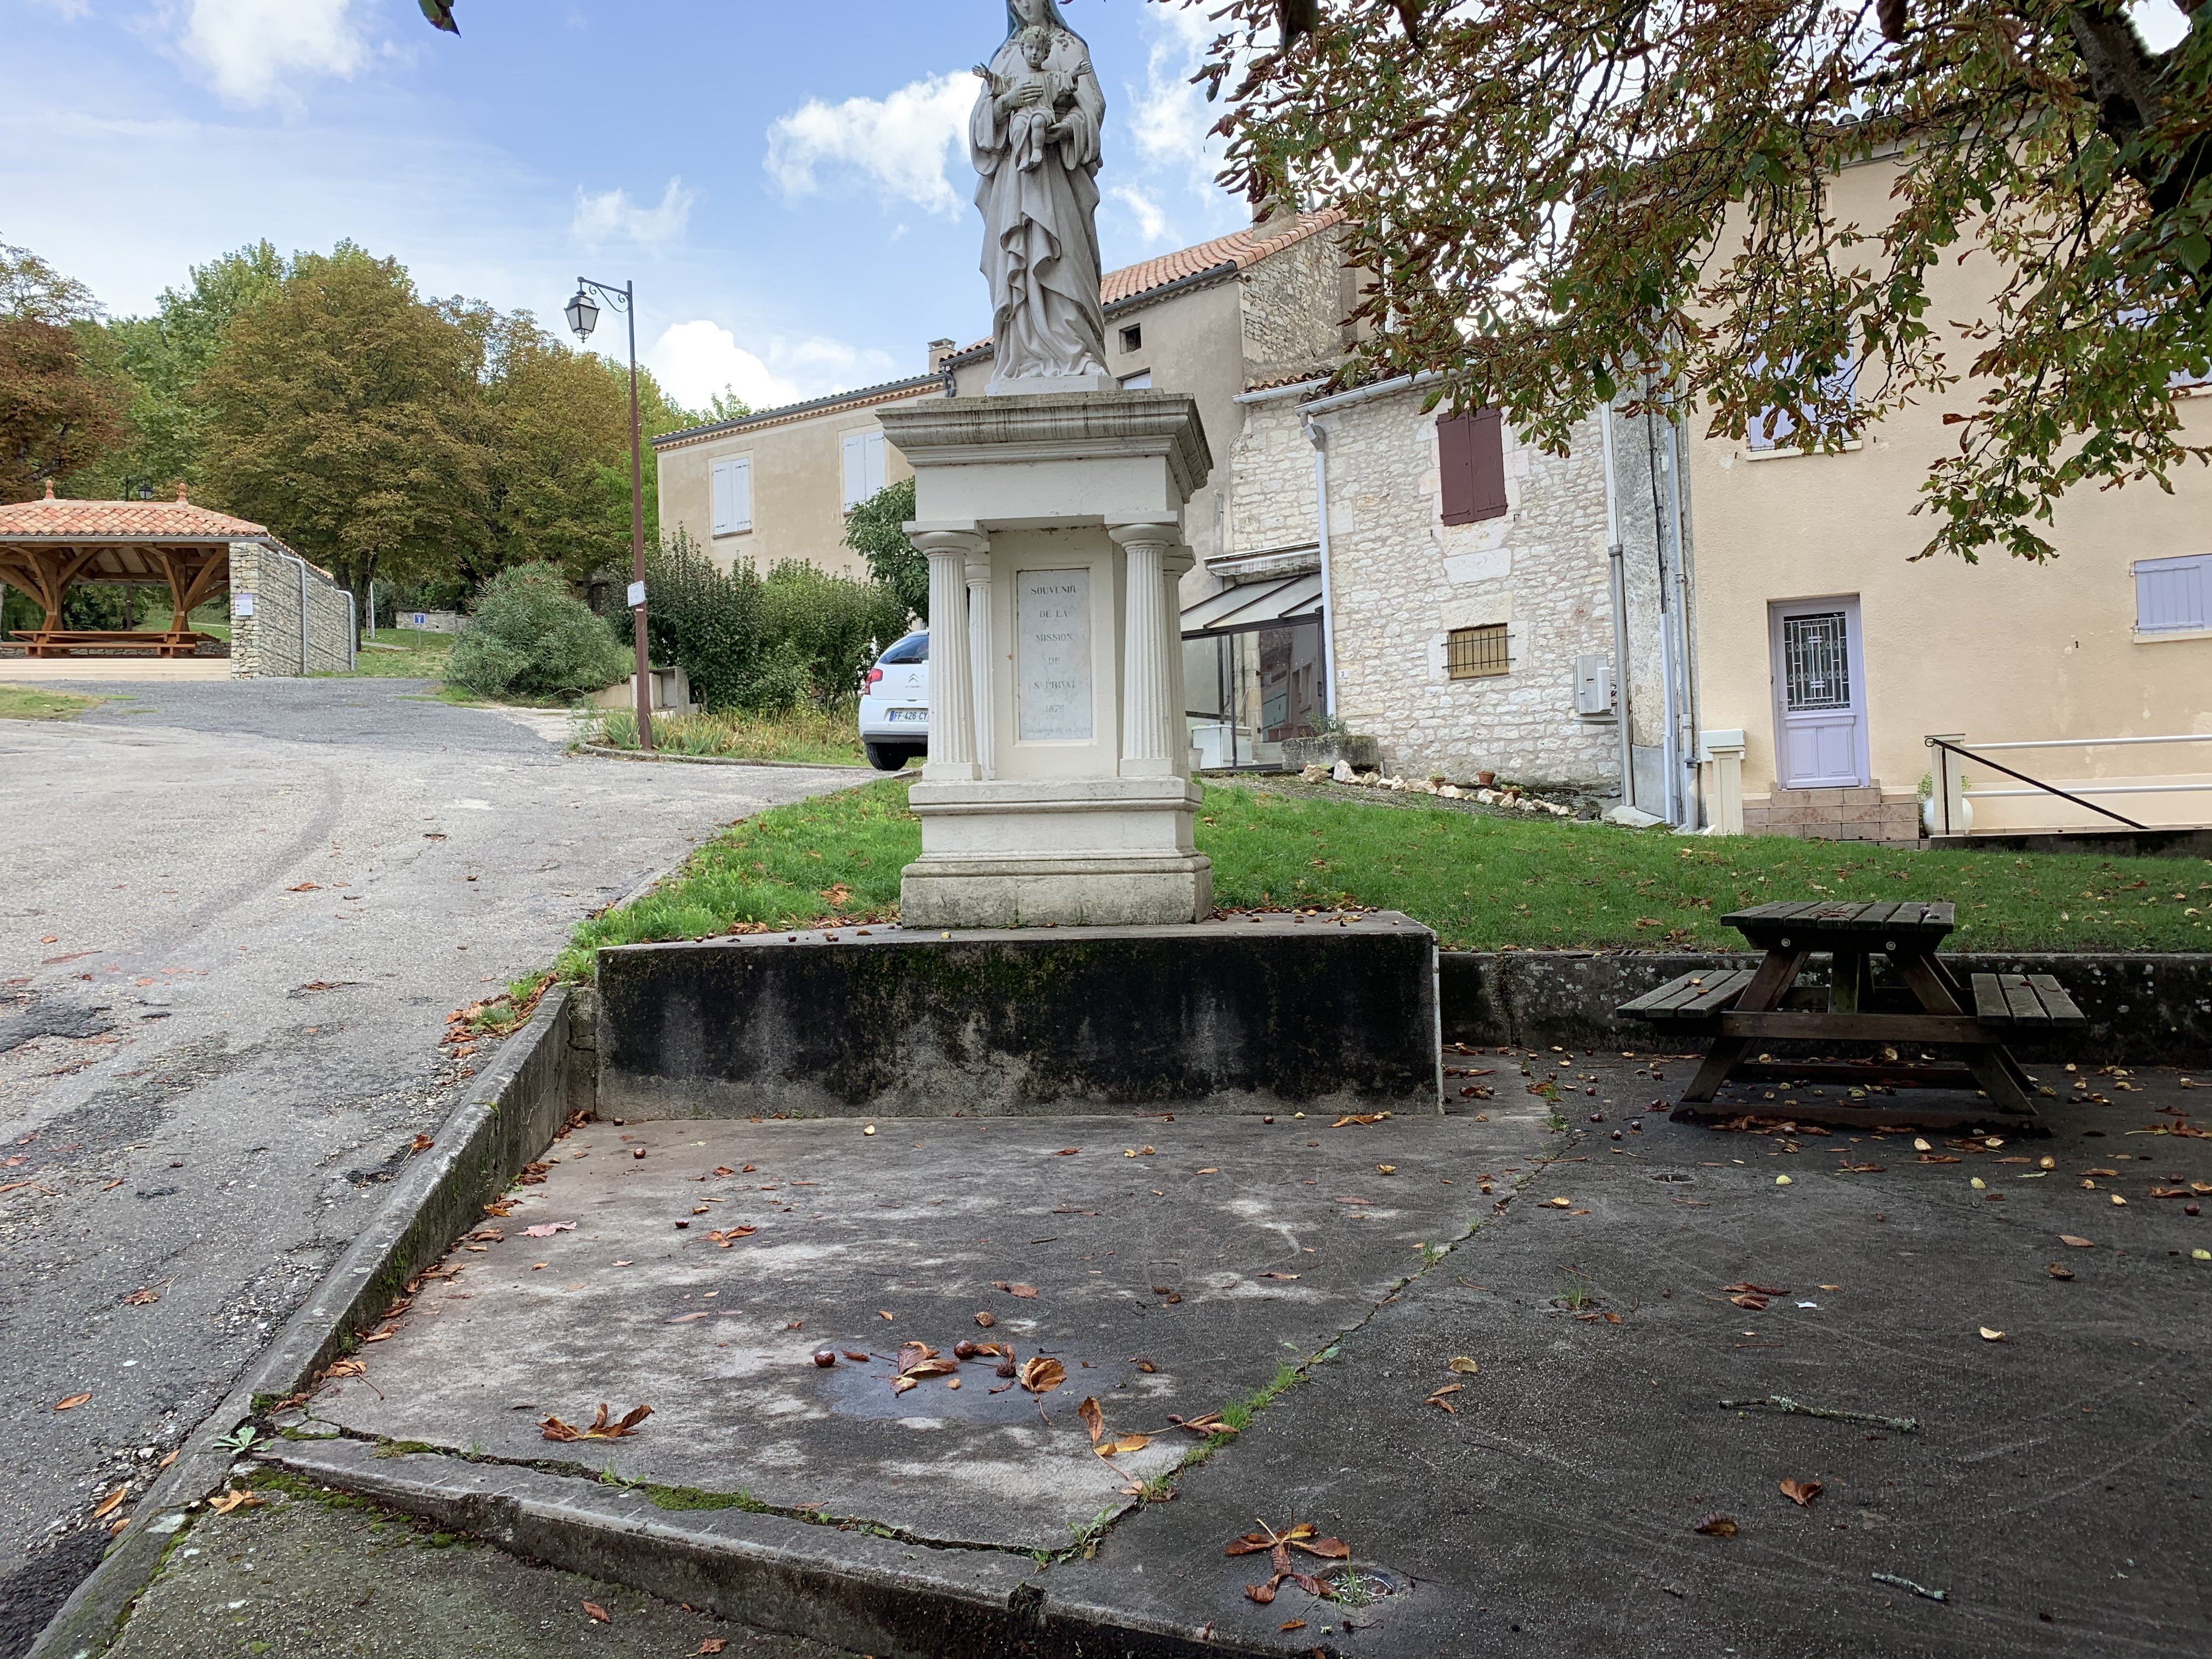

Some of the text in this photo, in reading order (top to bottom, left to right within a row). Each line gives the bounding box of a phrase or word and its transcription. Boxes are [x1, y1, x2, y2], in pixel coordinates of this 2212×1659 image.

[1031, 585, 1076, 595] SOUVENIR
[1040, 609, 1068, 618] DE LA
[1036, 633, 1073, 642] MISSION
[1046, 680, 1076, 689] PRIVAT
